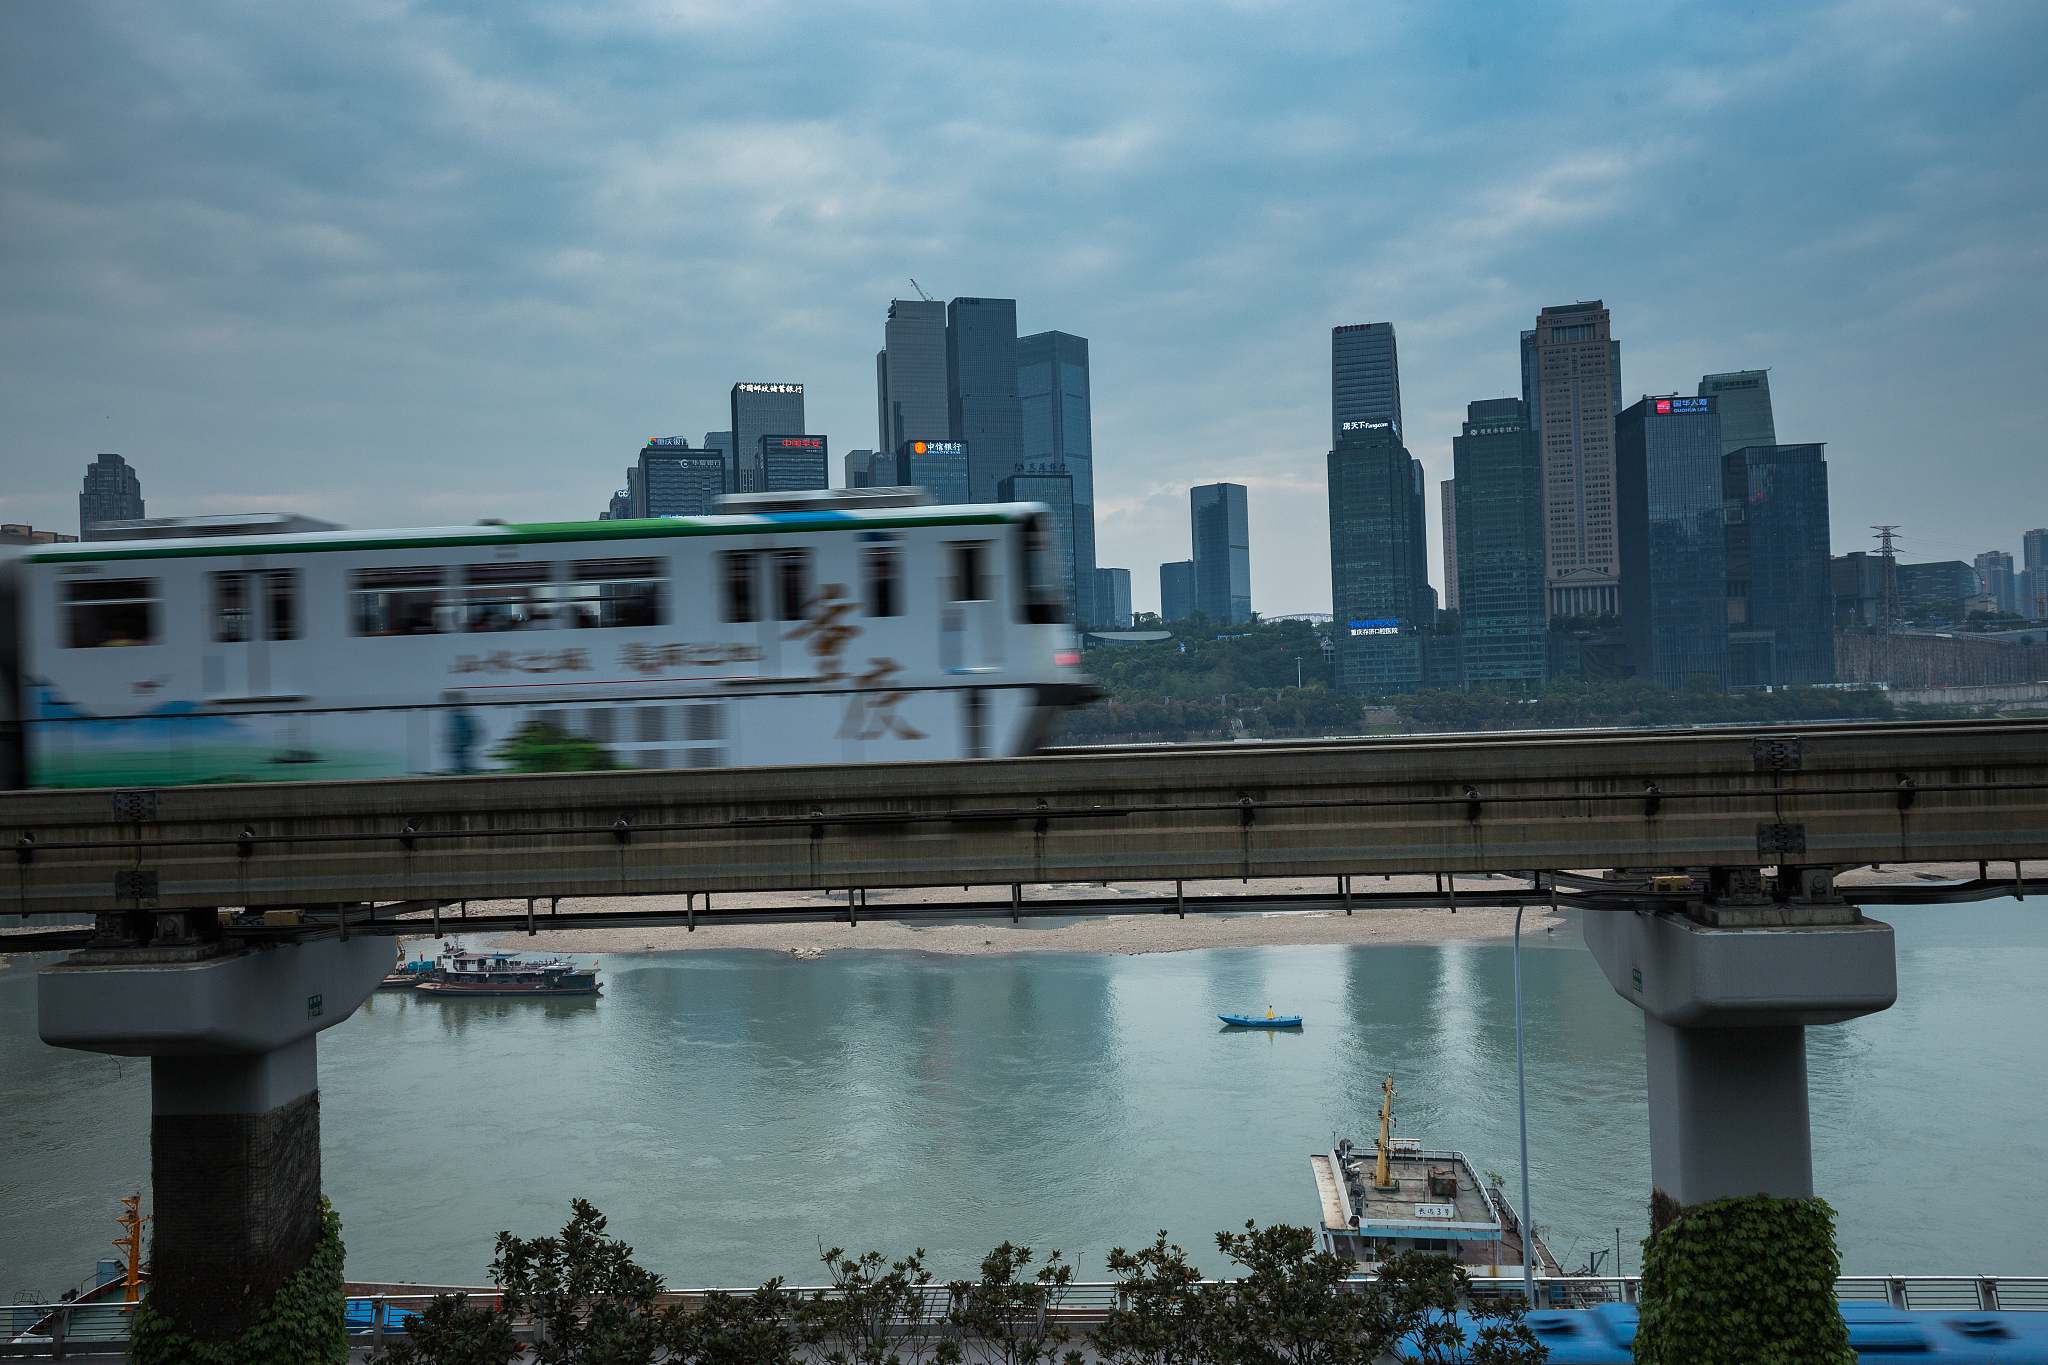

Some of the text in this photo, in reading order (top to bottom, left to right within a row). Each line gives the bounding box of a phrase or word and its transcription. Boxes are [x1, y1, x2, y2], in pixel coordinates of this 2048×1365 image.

[738, 383, 803, 394] 中国邮政储蓄银行
[1673, 398, 1708, 407] 国华人寿
[1342, 421, 1366, 430] 房天下
[657, 438, 688, 446] 重庆银行
[782, 439, 820, 447] 中国平安
